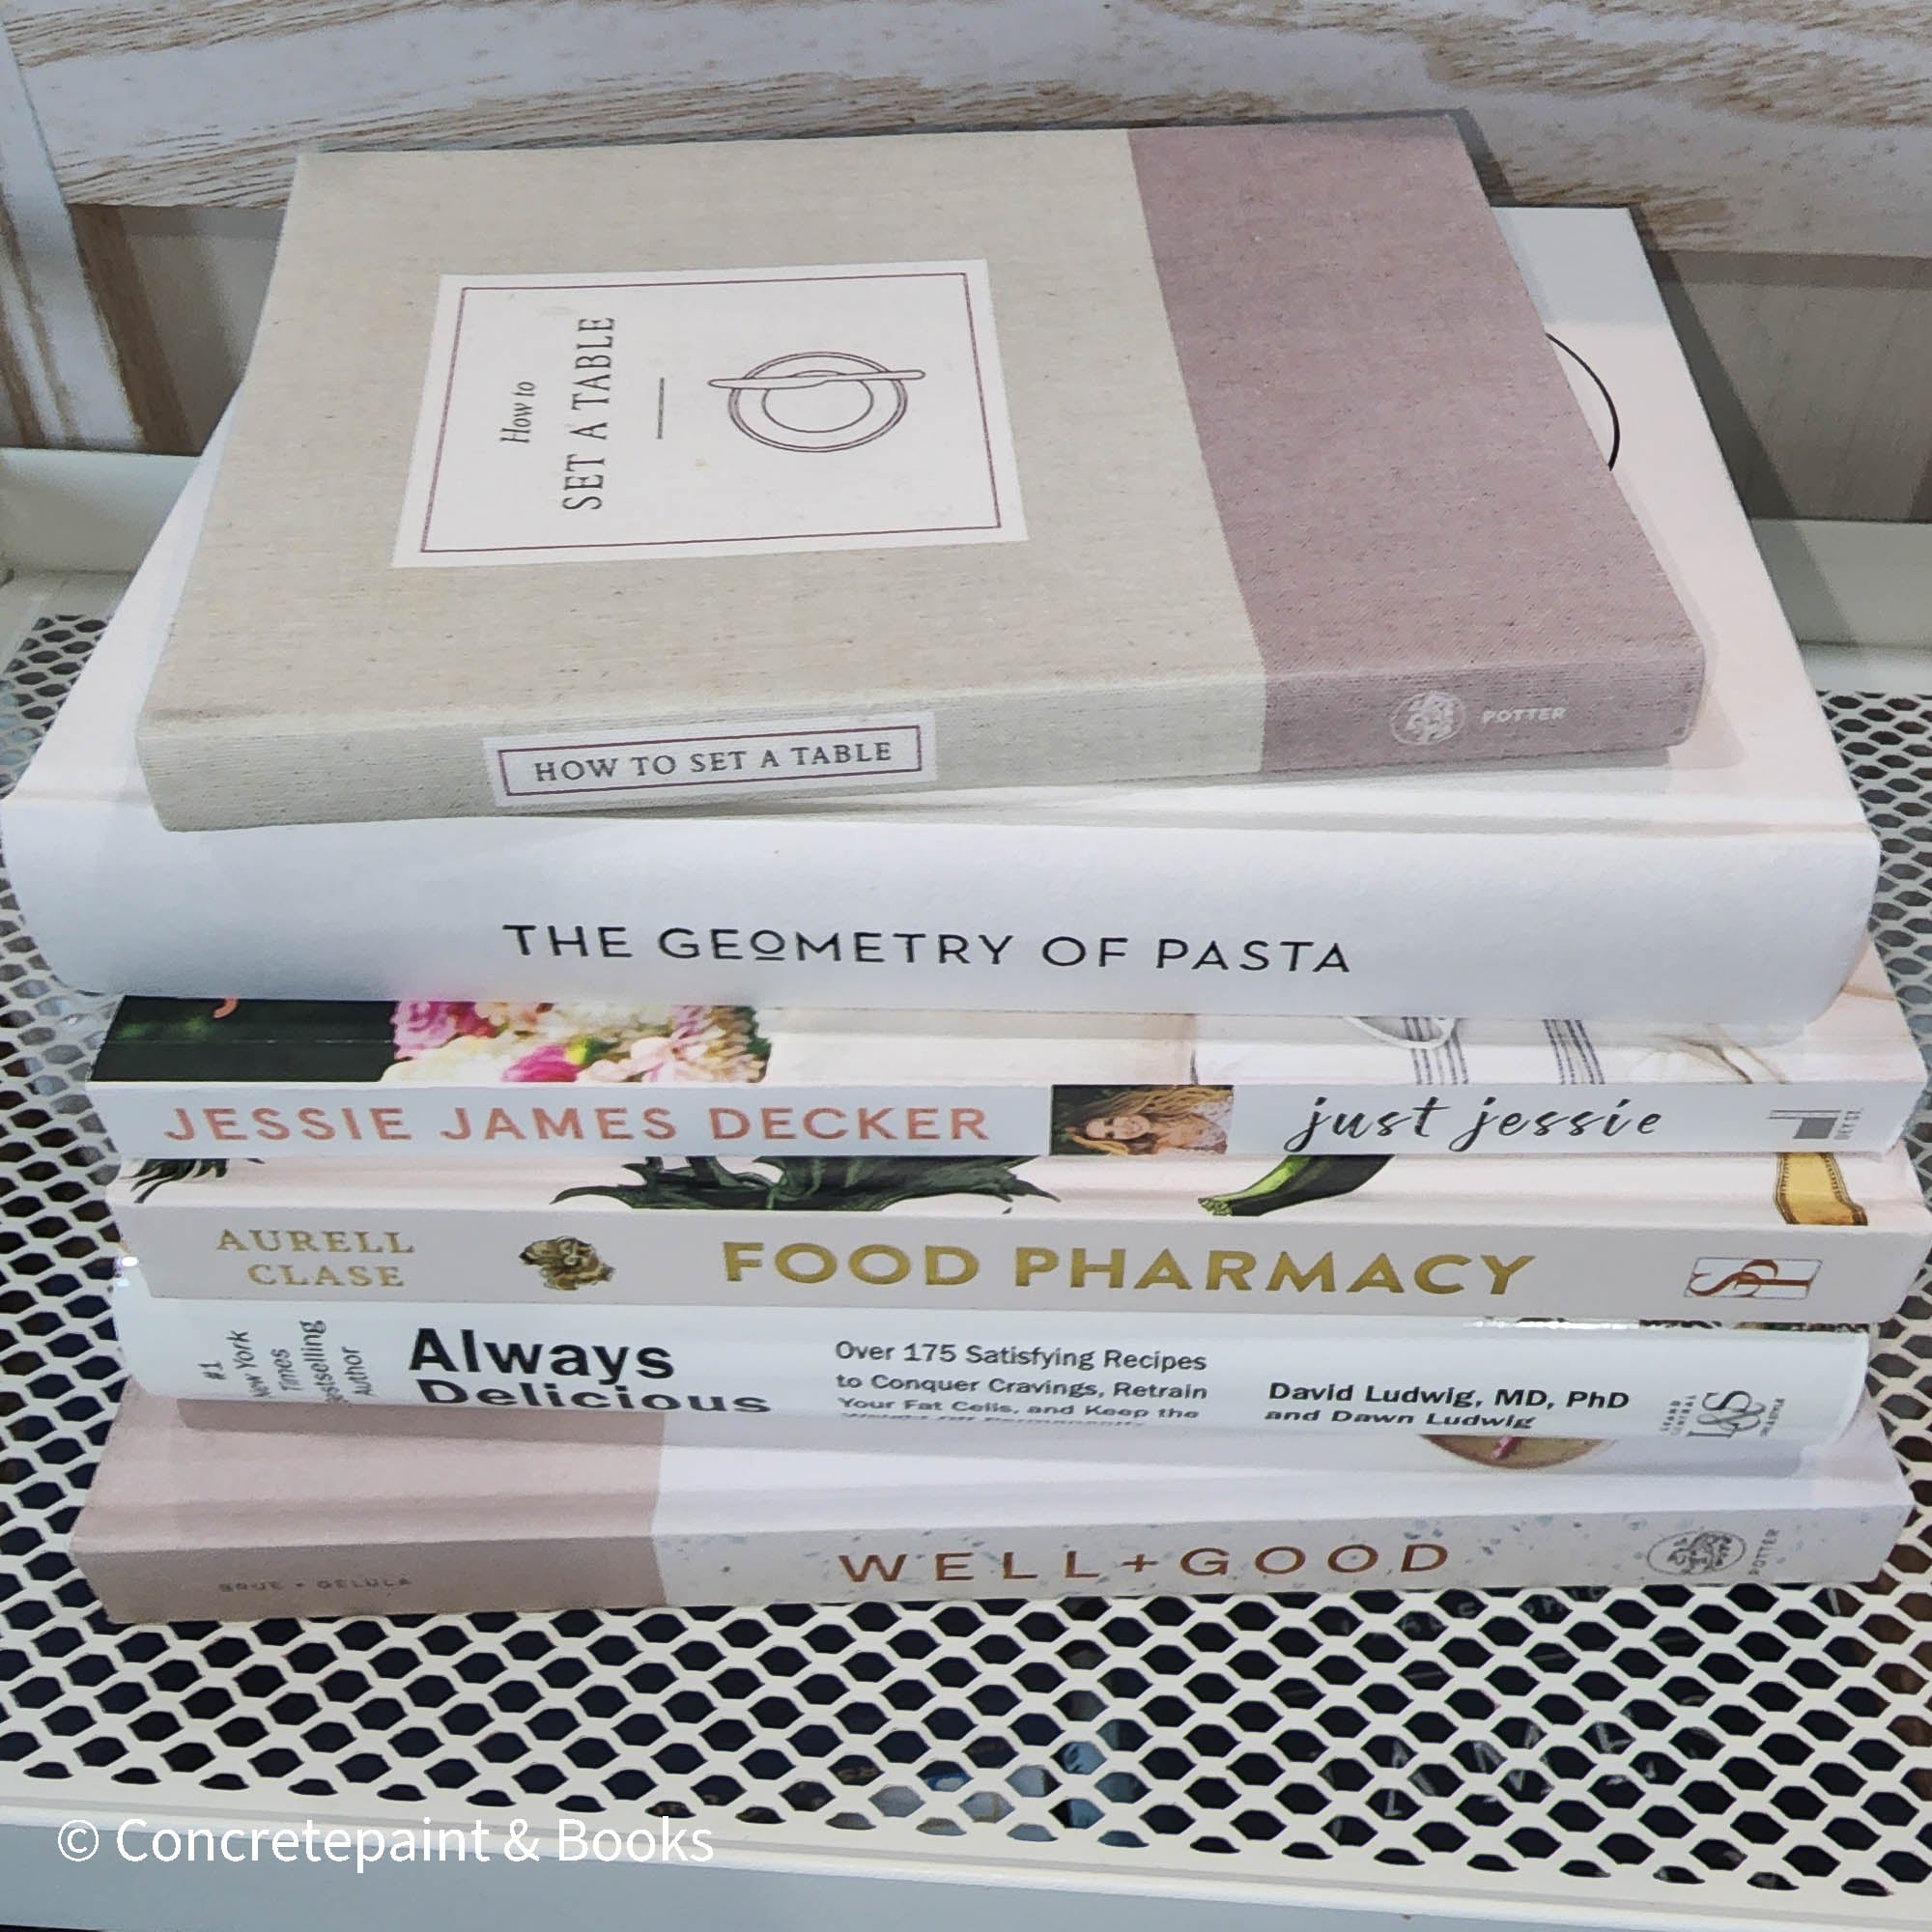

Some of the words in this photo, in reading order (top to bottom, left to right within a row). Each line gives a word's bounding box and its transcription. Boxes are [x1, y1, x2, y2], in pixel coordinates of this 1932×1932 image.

[571, 317, 615, 411] TABLE
[514, 381, 535, 397] to
[499, 402, 532, 443] How
[570, 422, 608, 440] A
[562, 453, 606, 510] SET
[1482, 706, 1567, 725] POTTER
[533, 756, 618, 782] HOW
[630, 754, 676, 777] TO
[690, 751, 747, 773] SET
[760, 750, 780, 769] A
[790, 741, 892, 766] TABLE
[501, 923, 633, 958] THE
[657, 926, 1013, 965] GEOMETRY
[1041, 936, 1128, 968] OF
[1155, 938, 1350, 973] PASTA
[163, 1107, 412, 1141] JESSIE
[440, 1107, 677, 1141] JAMES
[708, 1107, 988, 1141] DECKER
[1282, 1095, 1452, 1153] just
[1448, 1096, 1662, 1153] jessie
[216, 1228, 414, 1254] AURELL
[246, 1264, 405, 1288] CLASE
[722, 1240, 980, 1286] FOOD
[1014, 1246, 1536, 1295] PHARMACY
[226, 1329, 258, 1370] York
[408, 1326, 675, 1386] Always
[835, 1340, 895, 1361] Over
[903, 1343, 957, 1363] 175
[965, 1344, 1095, 1372] Satisfying
[1103, 1349, 1207, 1373] Recipes
[270, 1348, 304, 1392] Times
[836, 1374, 863, 1389] to
[870, 1374, 980, 1394] Conquer
[987, 1378, 1104, 1399] Cravings,
[1113, 1381, 1208, 1400] Retrain
[414, 1378, 772, 1414] Delicious
[1268, 1381, 1354, 1402] David
[1365, 1384, 1483, 1408] Ludwig,
[1493, 1388, 1554, 1410] MD,
[1566, 1390, 1630, 1409] PhD
[1264, 1409, 1321, 1422] and
[1331, 1409, 1414, 1424] Dawn
[1426, 1412, 1536, 1430] Ludwig
